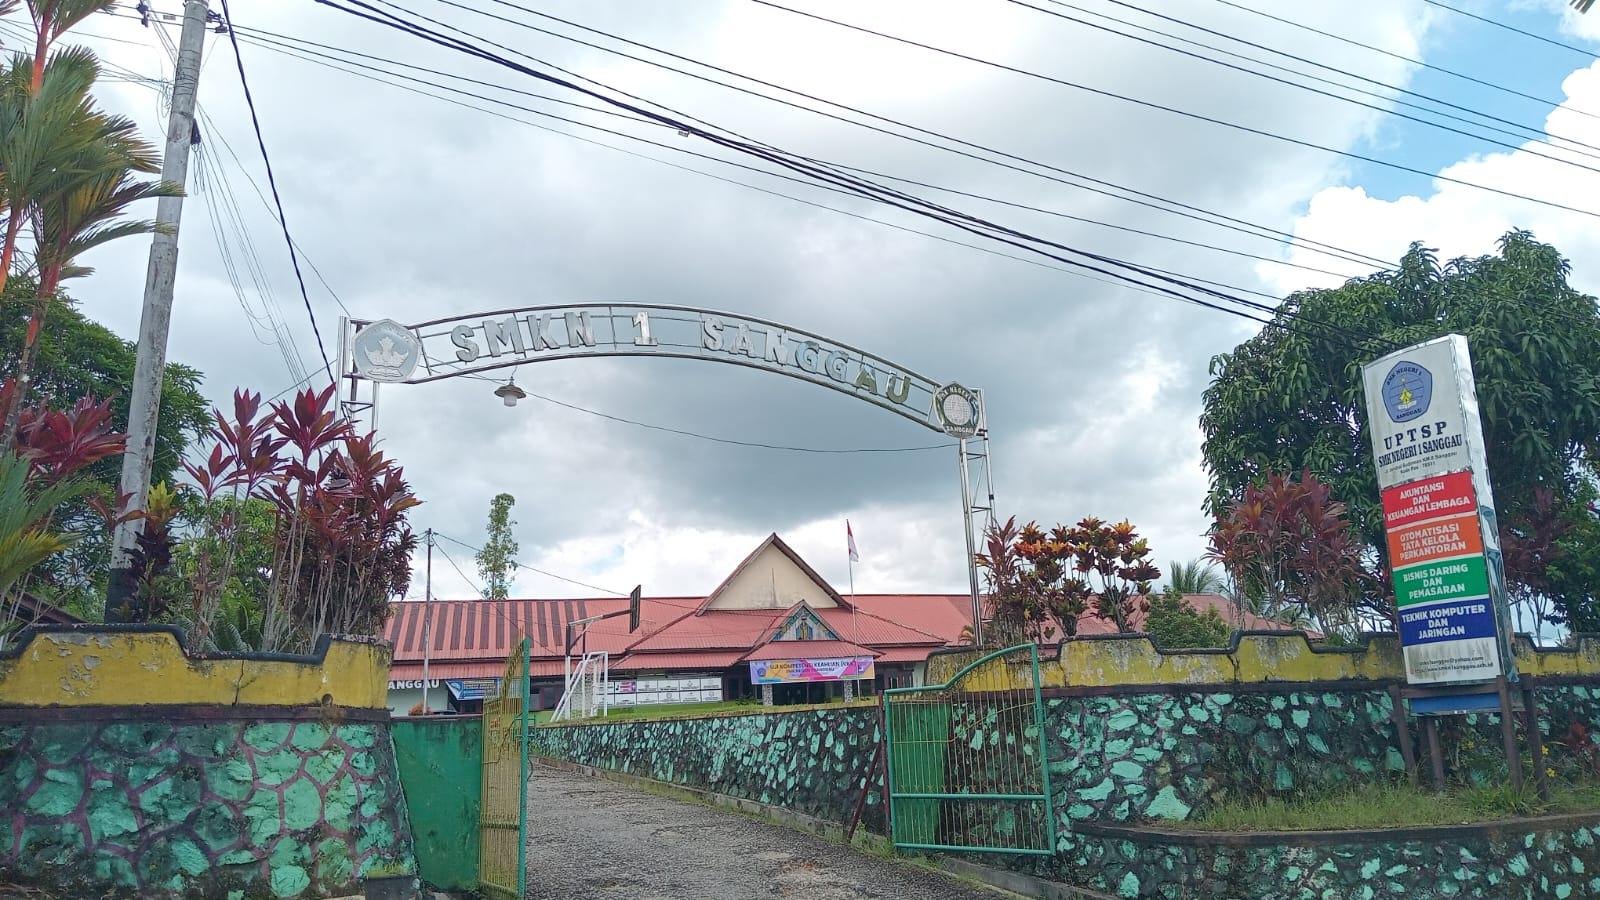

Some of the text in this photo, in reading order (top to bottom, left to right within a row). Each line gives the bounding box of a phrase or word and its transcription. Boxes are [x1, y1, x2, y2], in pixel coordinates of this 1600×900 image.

[450, 311, 912, 404] SMKN 1 SANGGAU
[1378, 453, 1392, 468] SMK
[1390, 444, 1417, 463] NEGERI
[1422, 434, 1463, 454] SANGGAU
[1400, 482, 1445, 499] AKUNTANSI
[1413, 494, 1430, 505] DAN
[1387, 496, 1471, 522] KEUANGAN LEMBAGA
[1400, 523, 1460, 542] OTOMATISASI
[1402, 532, 1460, 551] TATA KELOLA
[1400, 541, 1466, 560] PERKANTORAN
[1403, 563, 1469, 582] BISNIS DARING
[1423, 576, 1442, 588] DAN
[1408, 583, 1465, 600] PEMASARAN
[1402, 604, 1486, 623] TEKNIK KOMPUTER
[1428, 617, 1449, 628] DAN
[1418, 625, 1465, 639] JARINGAN
[388, 680, 440, 690] ANGGAU
